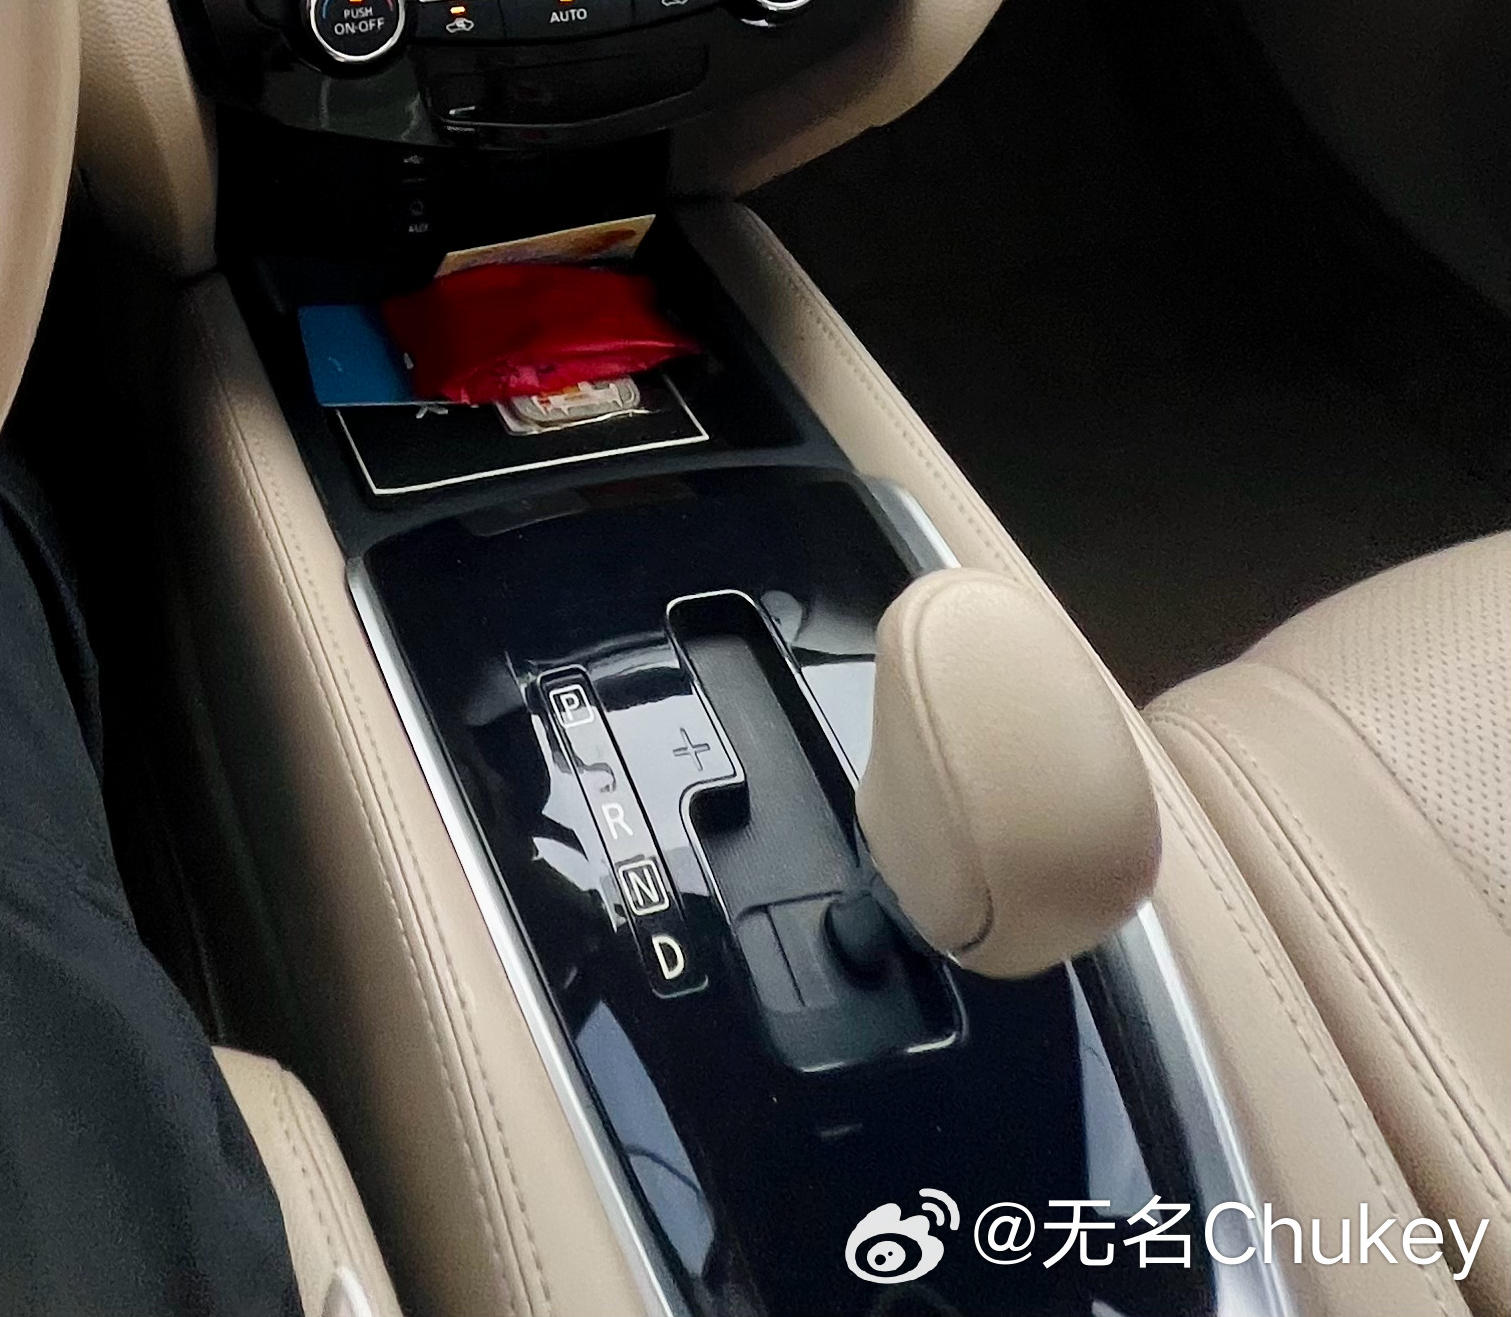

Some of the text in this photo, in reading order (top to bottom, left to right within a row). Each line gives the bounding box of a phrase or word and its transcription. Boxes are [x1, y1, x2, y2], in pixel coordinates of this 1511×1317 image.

[344, 6, 373, 18] PUSH
[549, 8, 588, 23] AUTO
[560, 693, 581, 721] P
[601, 802, 634, 841] R
[629, 871, 659, 907] N
[651, 934, 686, 980] D
